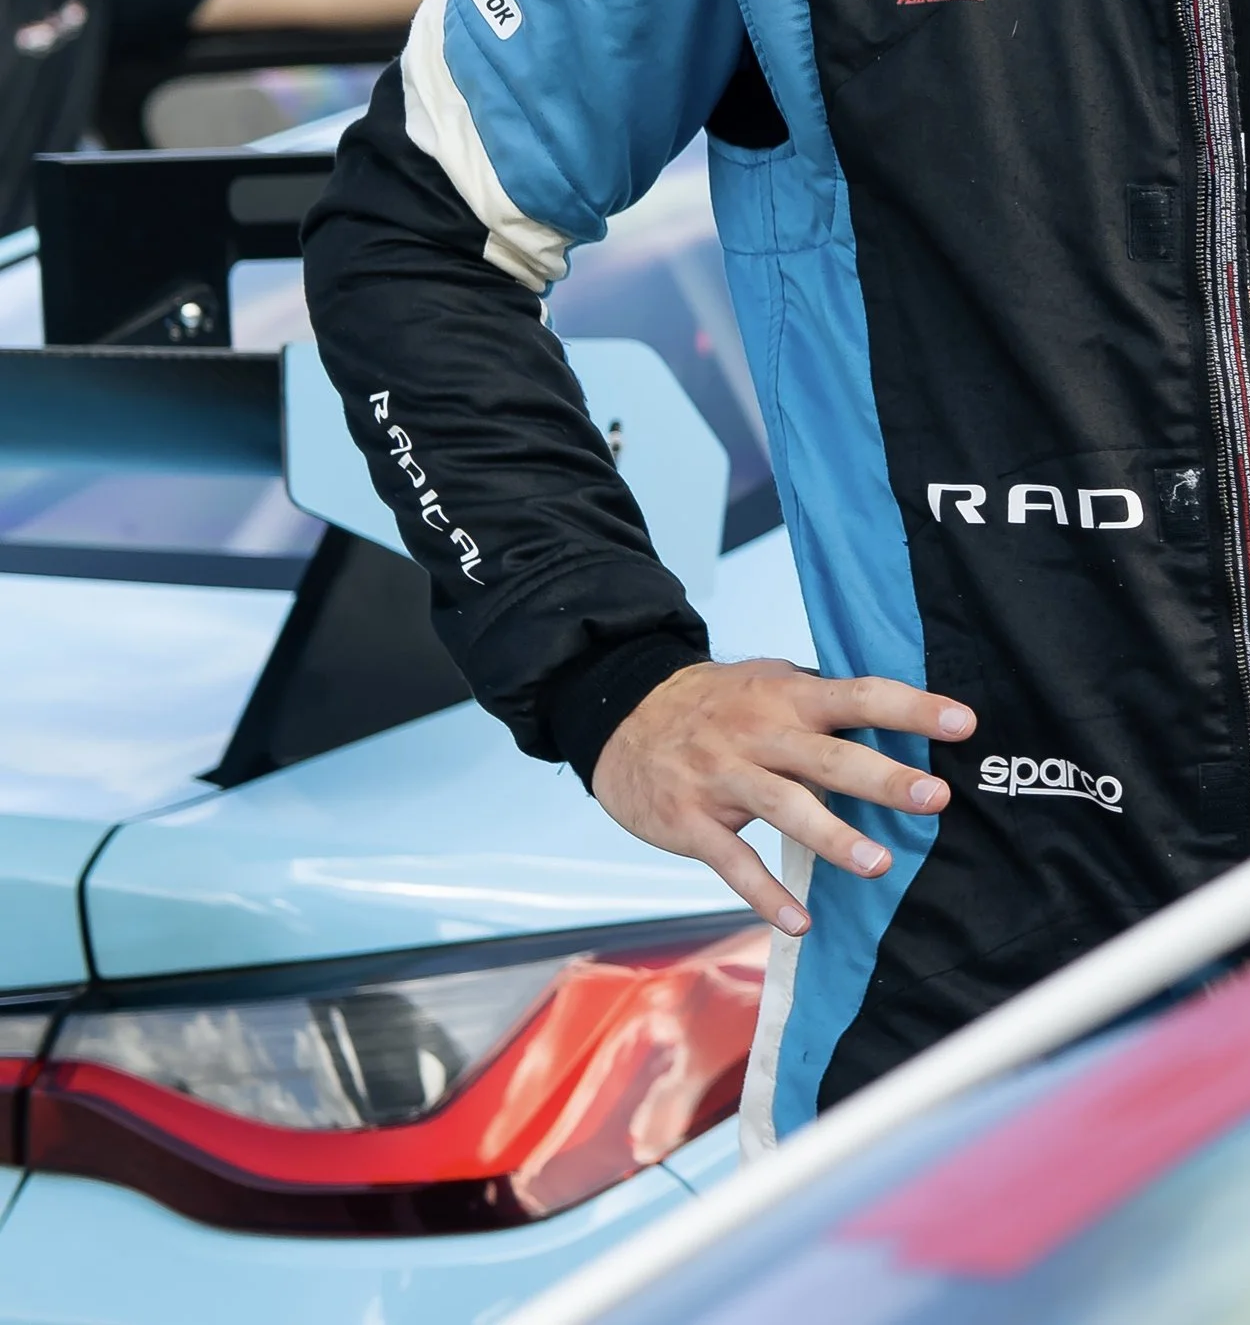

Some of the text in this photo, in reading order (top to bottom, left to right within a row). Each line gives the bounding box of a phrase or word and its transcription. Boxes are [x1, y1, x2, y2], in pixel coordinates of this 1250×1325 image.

[369, 390, 486, 586] RADICAL
[927, 482, 1144, 530] RAD
[977, 754, 1124, 814] sparco
